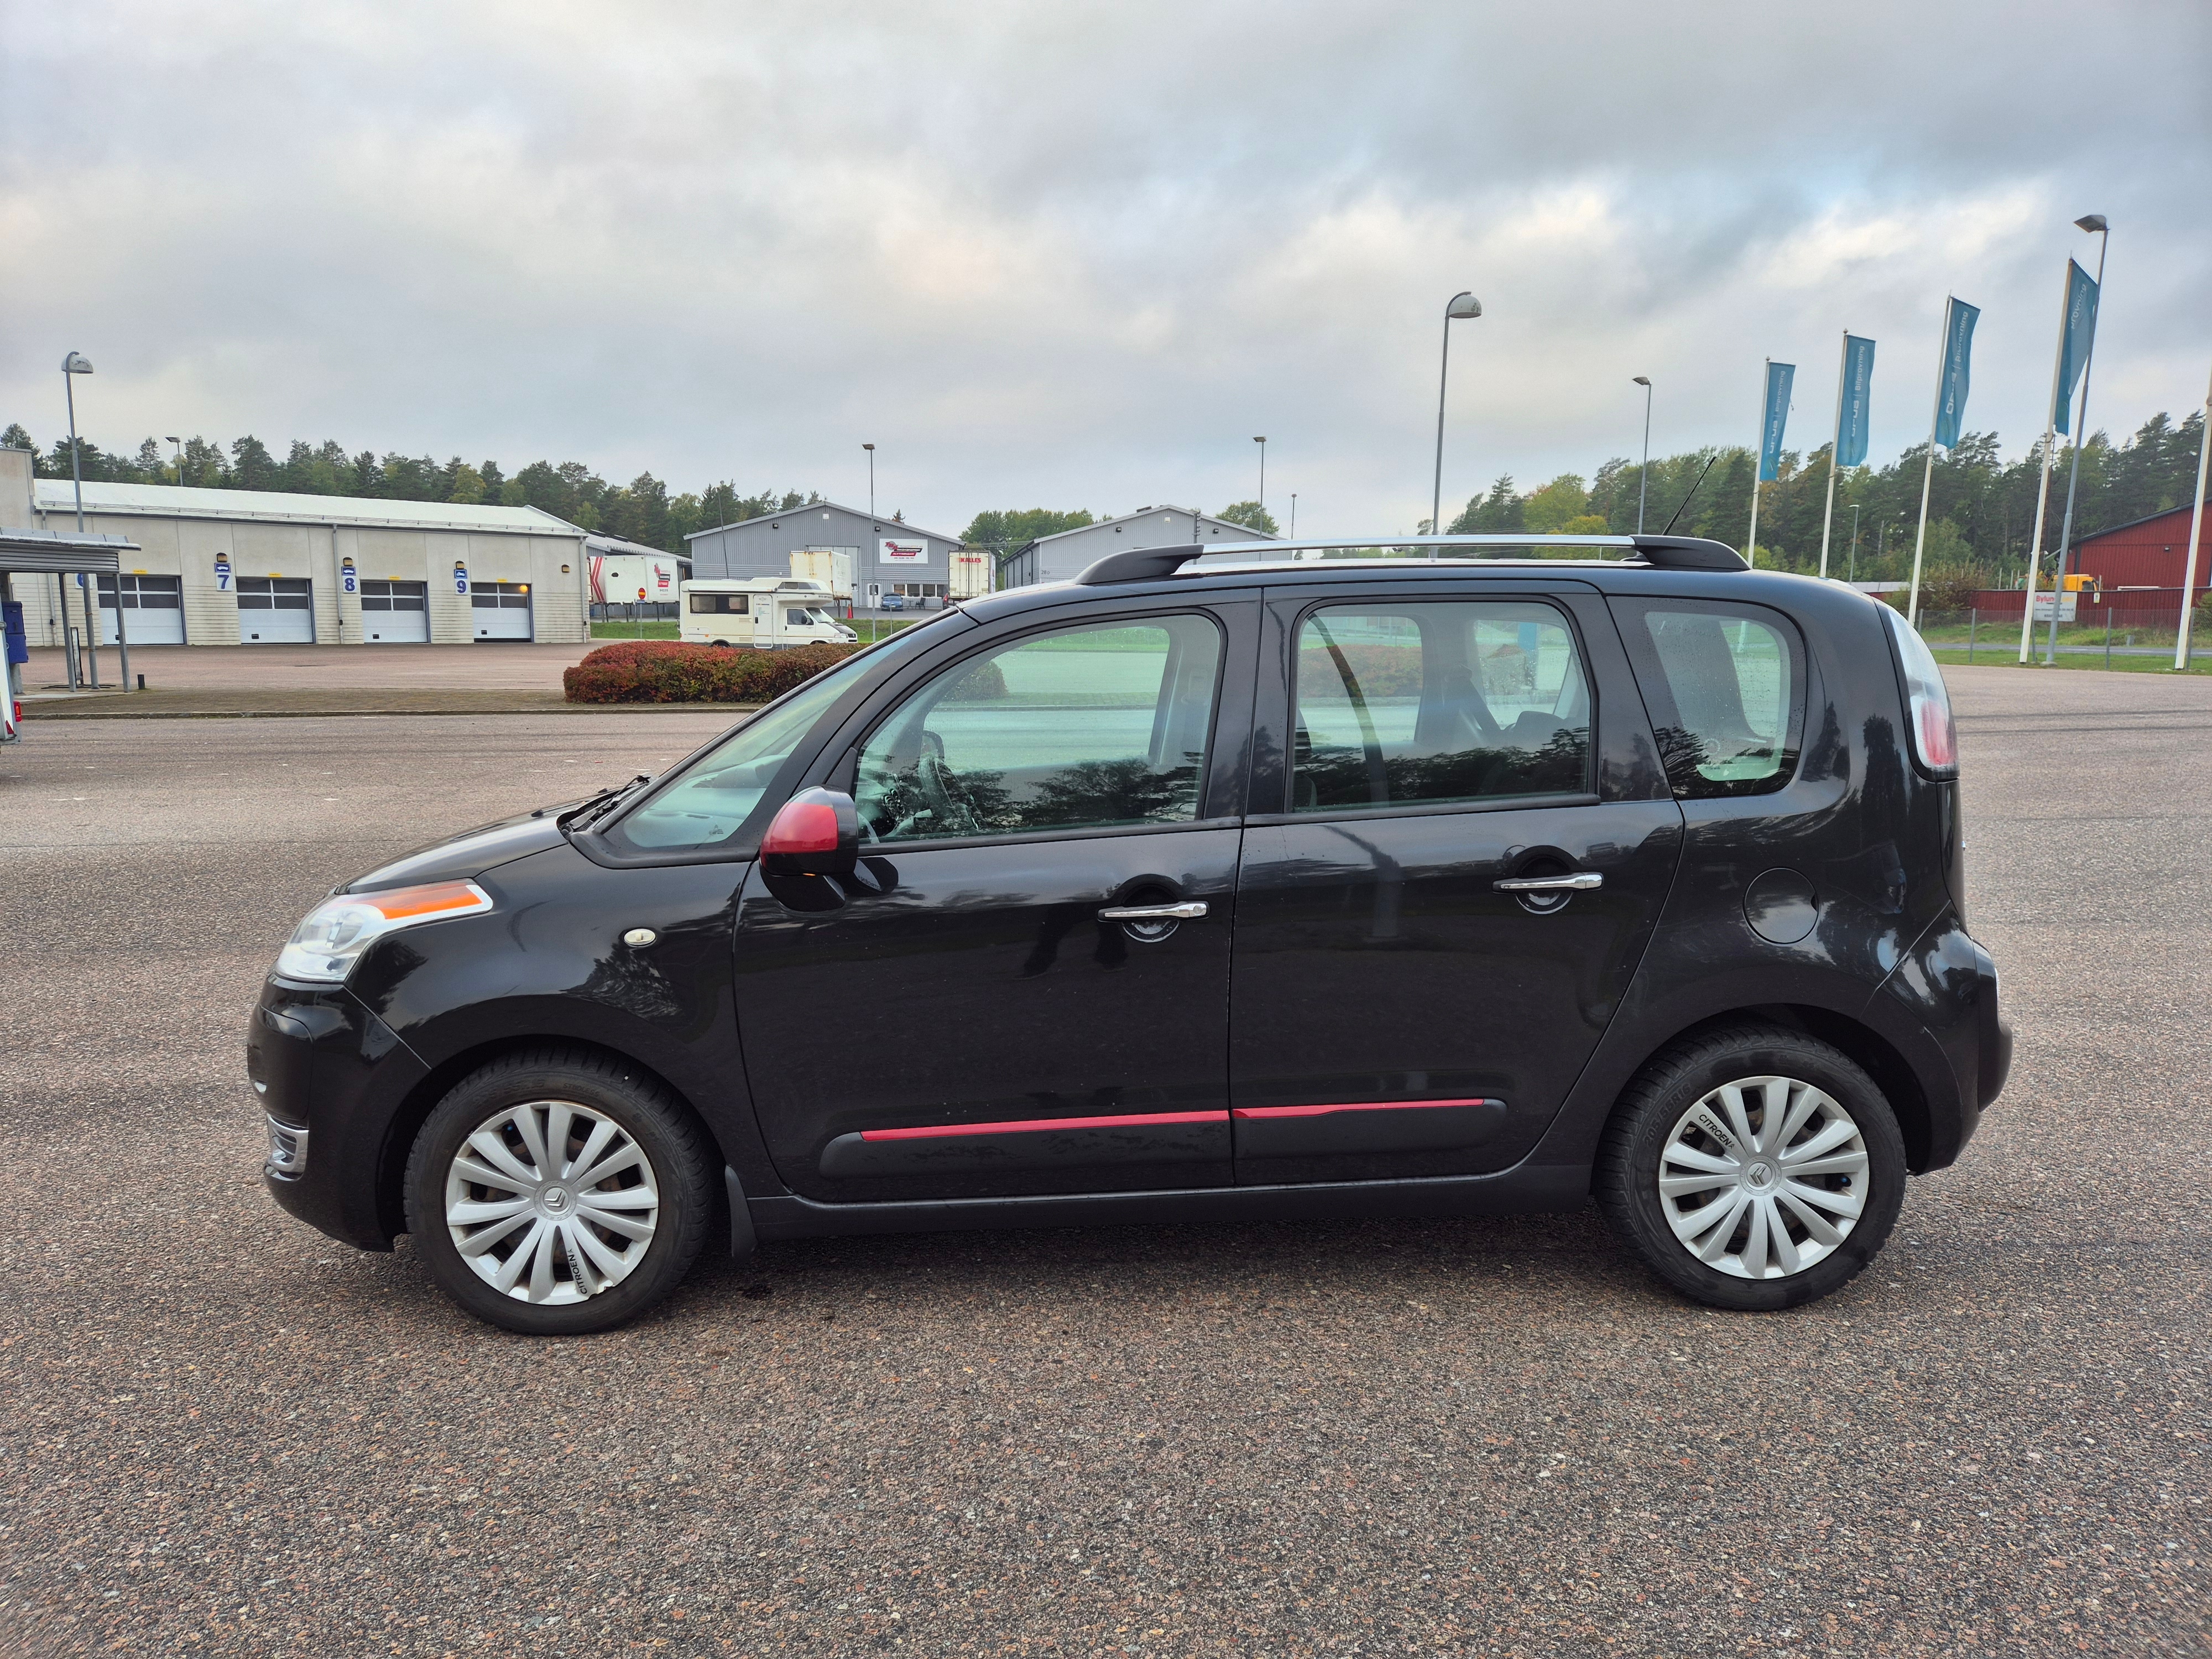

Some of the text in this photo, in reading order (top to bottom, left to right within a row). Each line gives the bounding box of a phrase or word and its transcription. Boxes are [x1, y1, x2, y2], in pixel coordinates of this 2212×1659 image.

[217, 575, 229, 589] 7
[345, 577, 355, 591] 8
[457, 580, 466, 593] 9
